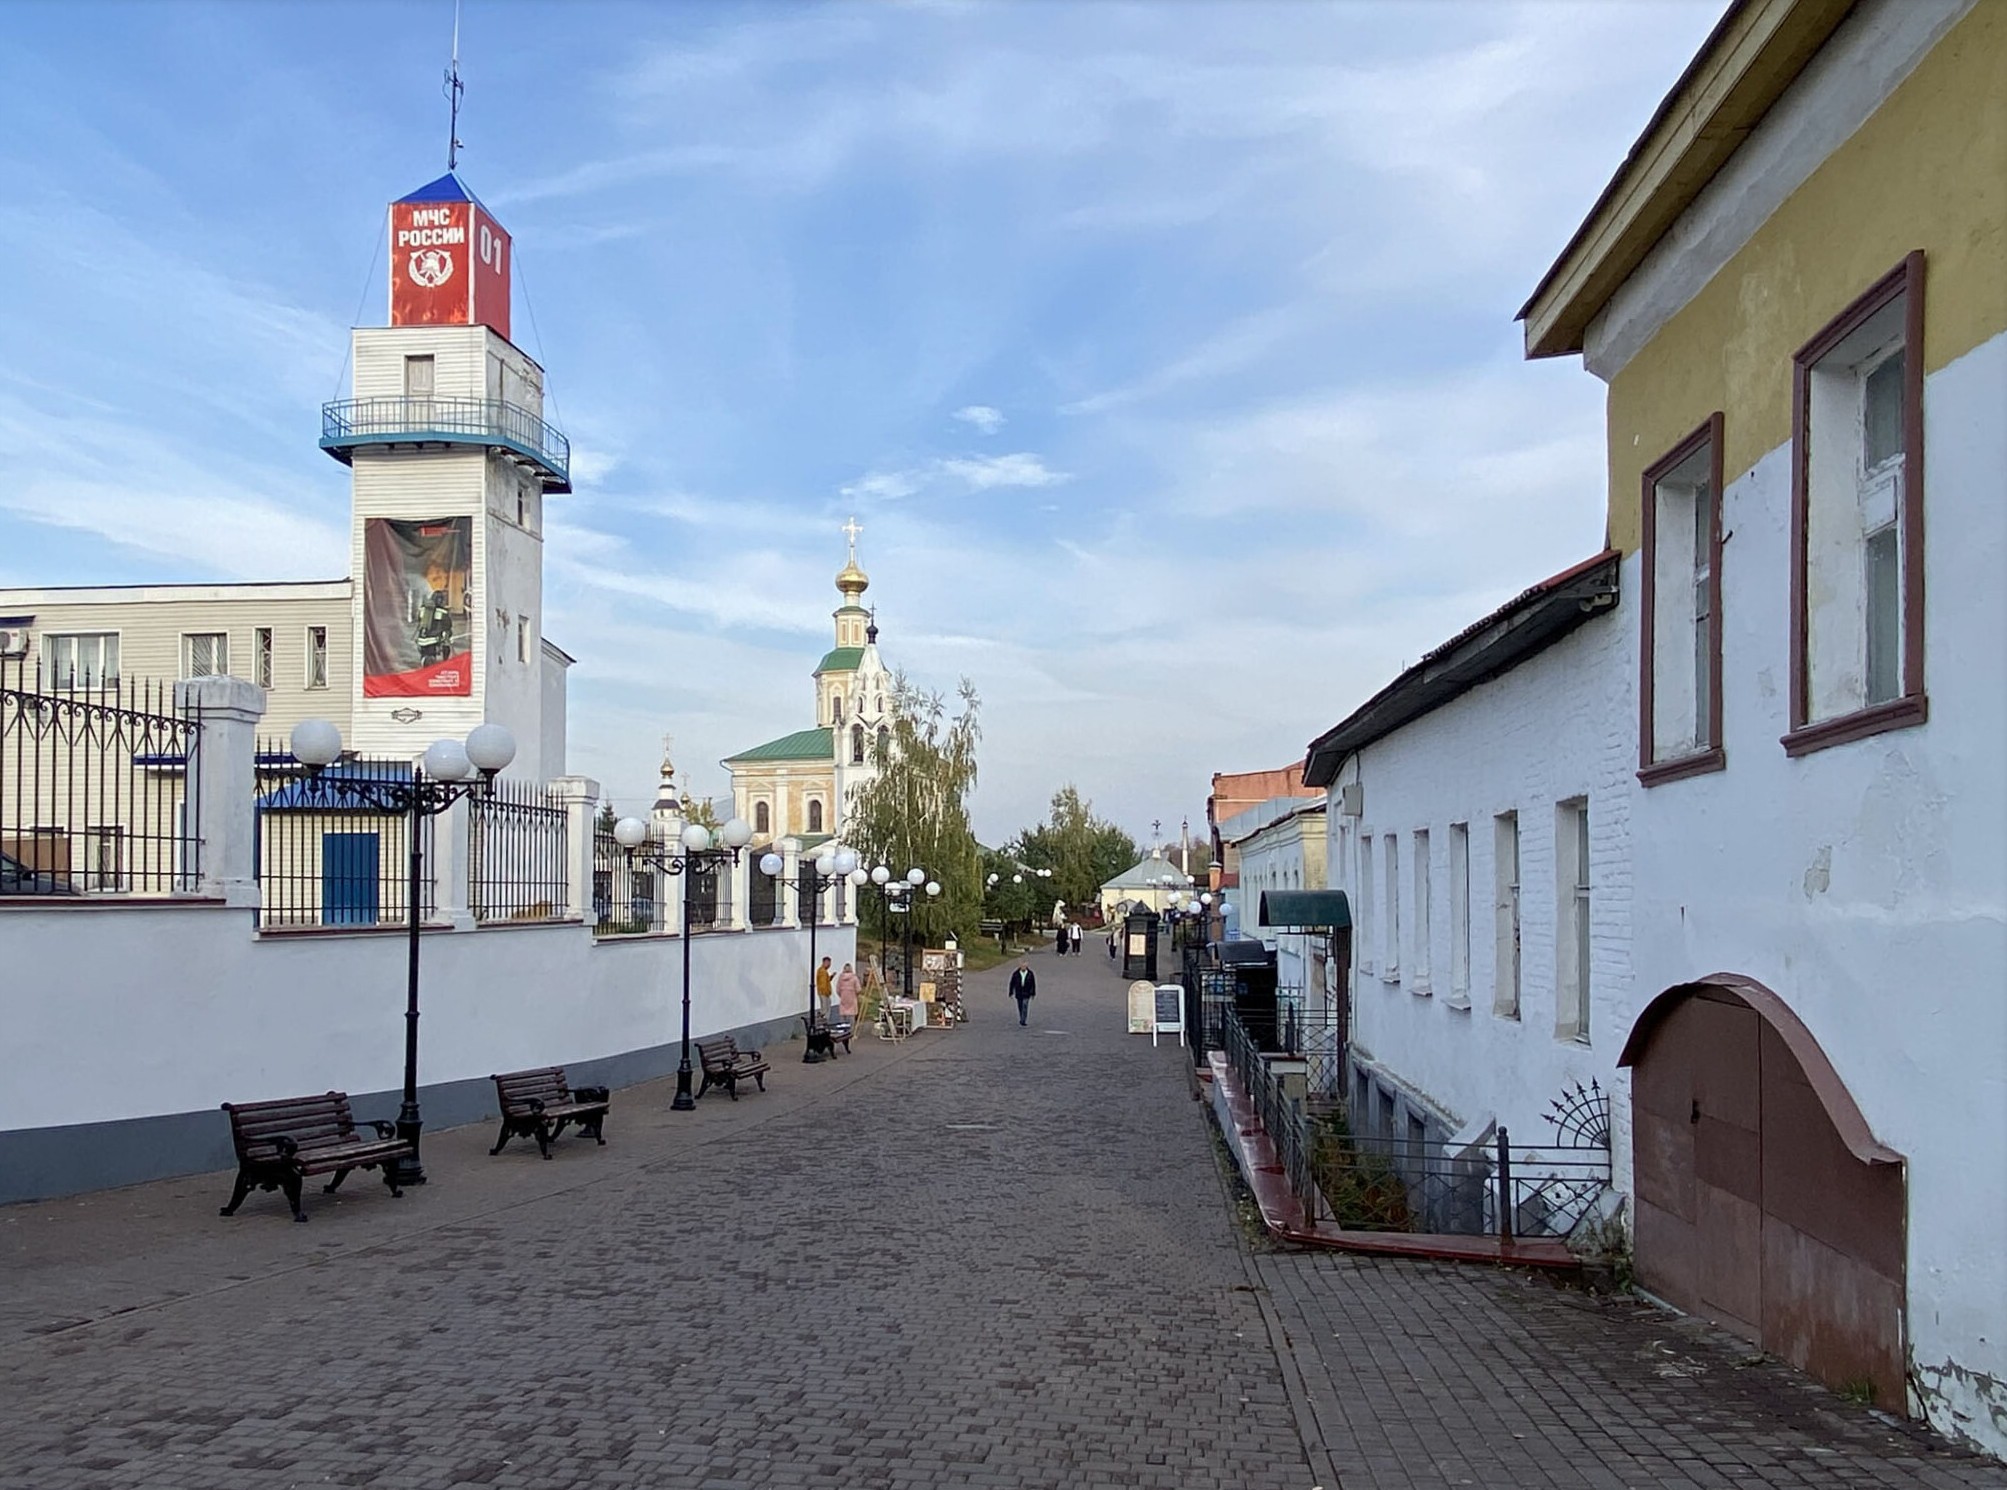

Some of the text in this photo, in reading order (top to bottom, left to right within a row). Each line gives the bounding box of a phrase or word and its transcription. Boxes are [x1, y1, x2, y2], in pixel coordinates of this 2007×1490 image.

[413, 208, 451, 227] МЧС
[398, 227, 465, 247] РОССИИ
[480, 225, 502, 274] 01
